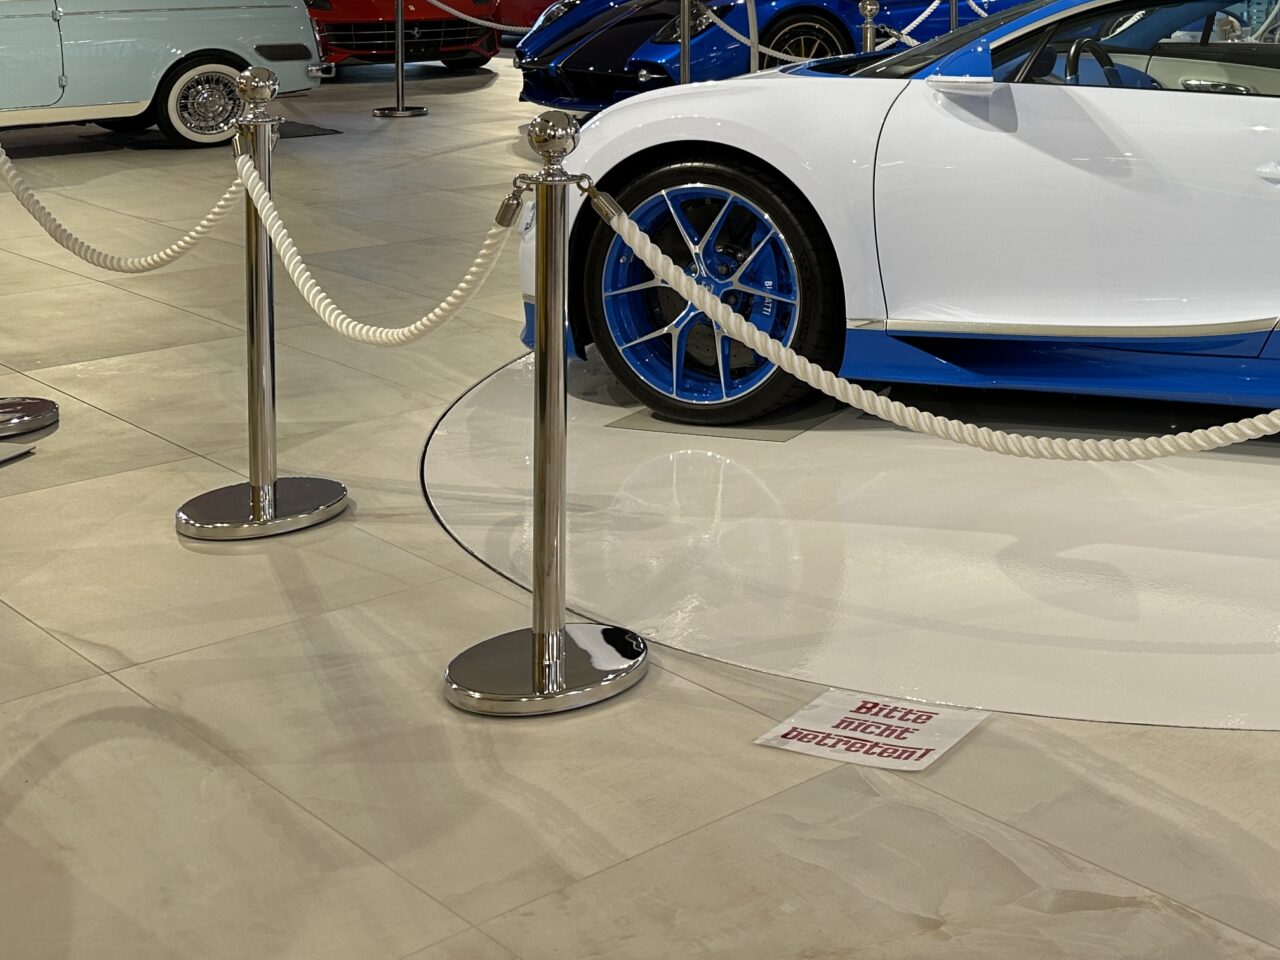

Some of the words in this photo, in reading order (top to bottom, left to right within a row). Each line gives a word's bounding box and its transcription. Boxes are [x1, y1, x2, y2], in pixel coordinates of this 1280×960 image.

[762, 280, 773, 316] BATTI
[849, 700, 939, 725] Bitte
[831, 716, 920, 741] nicht
[780, 726, 936, 762] betreten!
